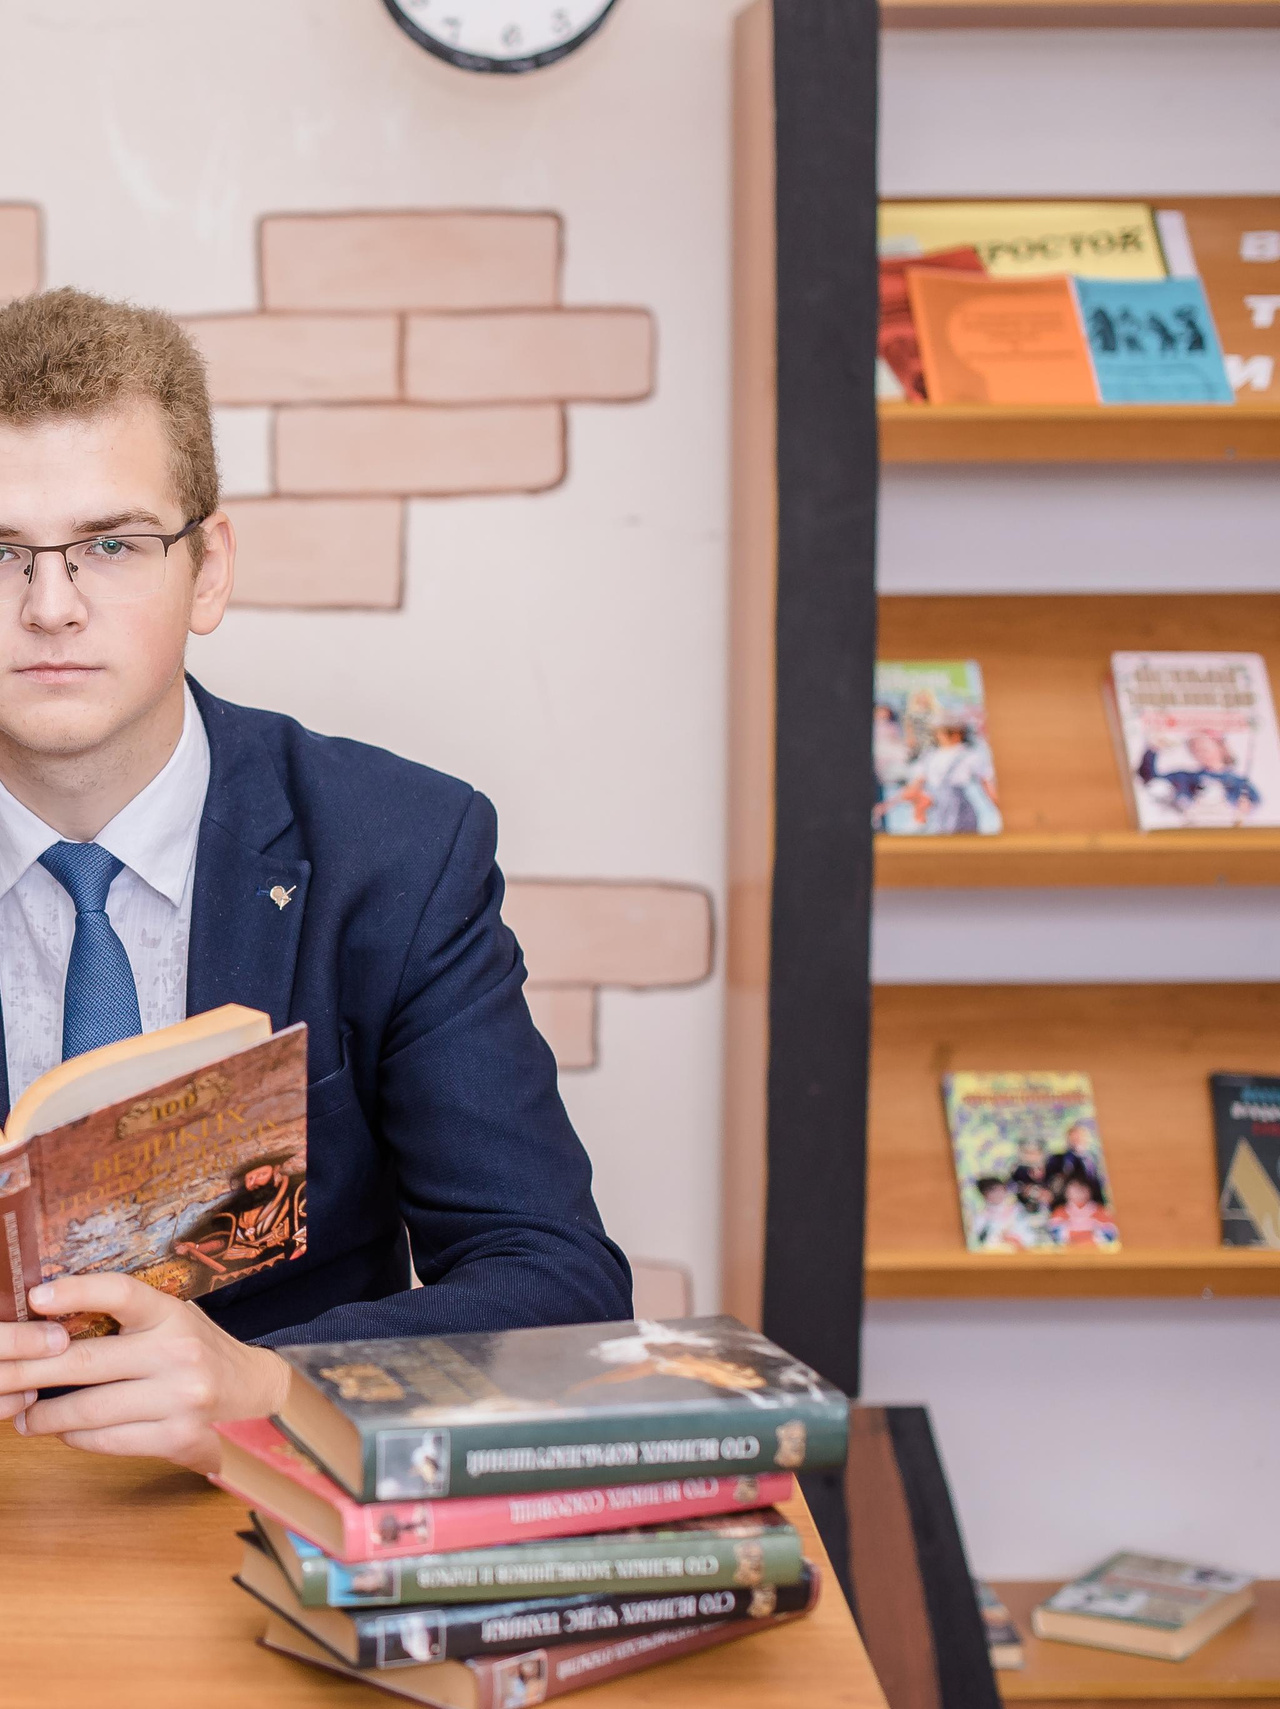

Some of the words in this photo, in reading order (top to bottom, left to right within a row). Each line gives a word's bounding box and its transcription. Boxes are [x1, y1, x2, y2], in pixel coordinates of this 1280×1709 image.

[151, 1091, 198, 1122] 100
[93, 1103, 251, 1182] ВЕЛИКИХ
[640, 1437, 720, 1464] ВЕЛИКИХ
[720, 1435, 760, 1460] СТО
[605, 1480, 681, 1511] ВЕЛИКИХ
[683, 1476, 719, 1500] СТО
[478, 1565, 494, 1587] И
[614, 1556, 684, 1579] ВЕЛИКИХ
[684, 1555, 719, 1576] СТО
[620, 1595, 697, 1626] ВЕЛИКИХ
[698, 1591, 735, 1615] СТО
[481, 1612, 560, 1644] ТЕХНИКИ
[563, 1605, 618, 1633] ЧУДЕС
